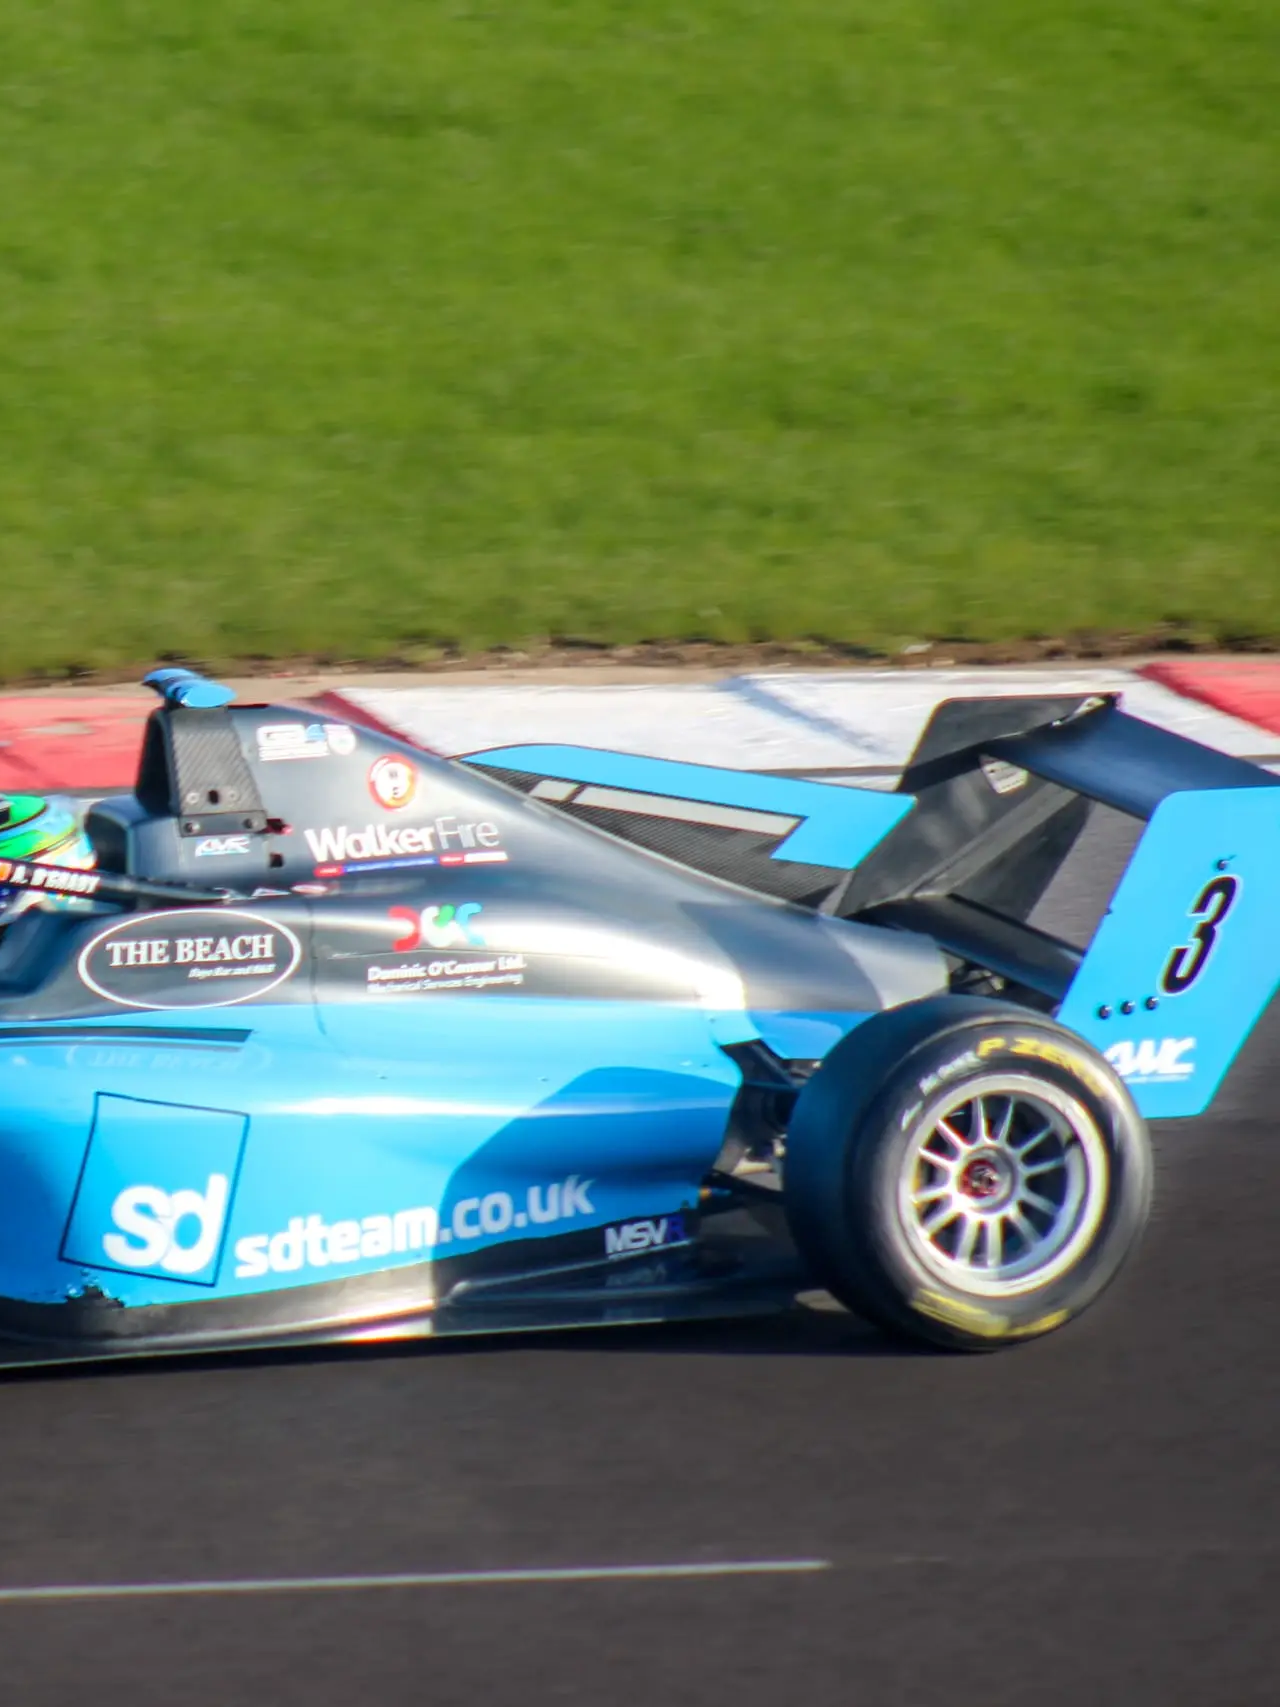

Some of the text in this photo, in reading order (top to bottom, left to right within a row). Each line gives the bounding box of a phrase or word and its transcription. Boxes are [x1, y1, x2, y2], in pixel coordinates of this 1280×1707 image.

[106, 934, 275, 967] THE BEACH
[1156, 874, 1243, 997] 3
[102, 1173, 228, 1274] sd
[234, 1174, 597, 1279] sdteam.co.uk
